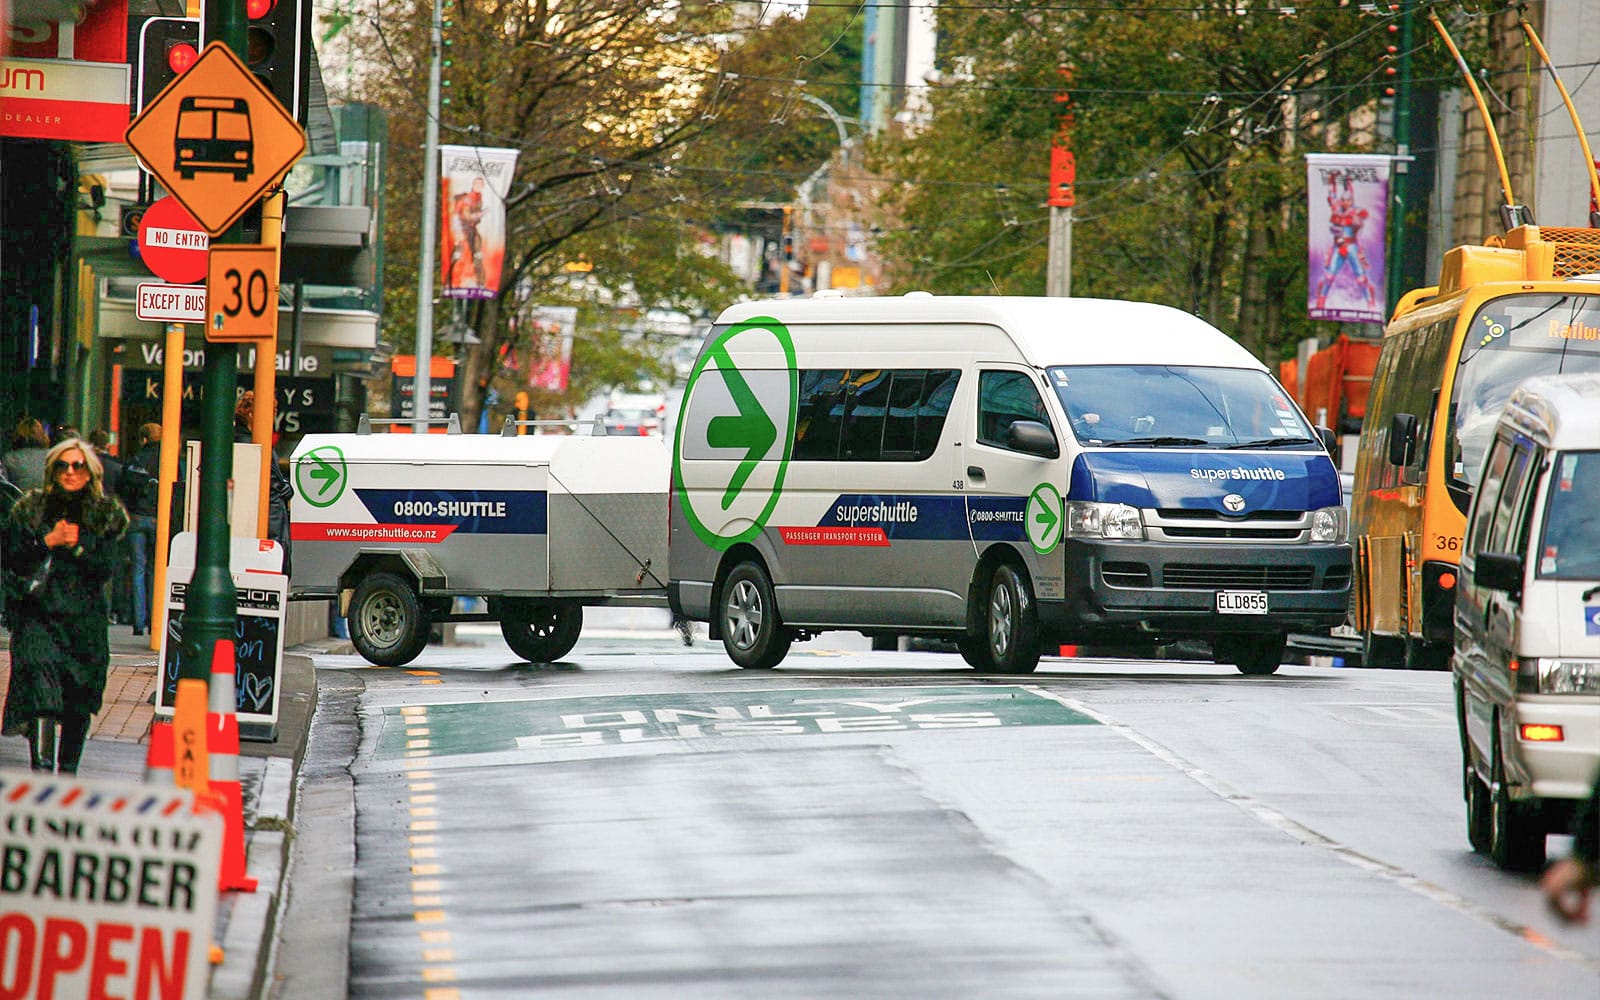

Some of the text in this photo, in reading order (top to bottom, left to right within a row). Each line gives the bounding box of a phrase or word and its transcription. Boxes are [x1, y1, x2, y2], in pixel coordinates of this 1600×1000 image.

[5, 113, 61, 124] DEALER
[155, 231, 207, 247] NO ENTRY
[223, 268, 268, 317] 30
[142, 293, 207, 312] EXCEPT BUS
[1548, 319, 1600, 341] Railw
[1190, 467, 1285, 482] supershuttle
[952, 480, 964, 490] 438
[394, 501, 506, 517] 0800-SHUTTLE
[836, 501, 918, 528] supershuttle
[976, 511, 1024, 522] 0800-SHUTTLE
[326, 527, 437, 540] www.supershuttle.co.nz
[785, 532, 883, 542] PASSENGER TRANSPORT SYSTEM
[1218, 595, 1267, 610] ELD855
[560, 699, 938, 730] ONLY
[515, 711, 1002, 749] BUSES
[0, 845, 198, 912] BARBER
[0, 911, 191, 1000] OPEN
